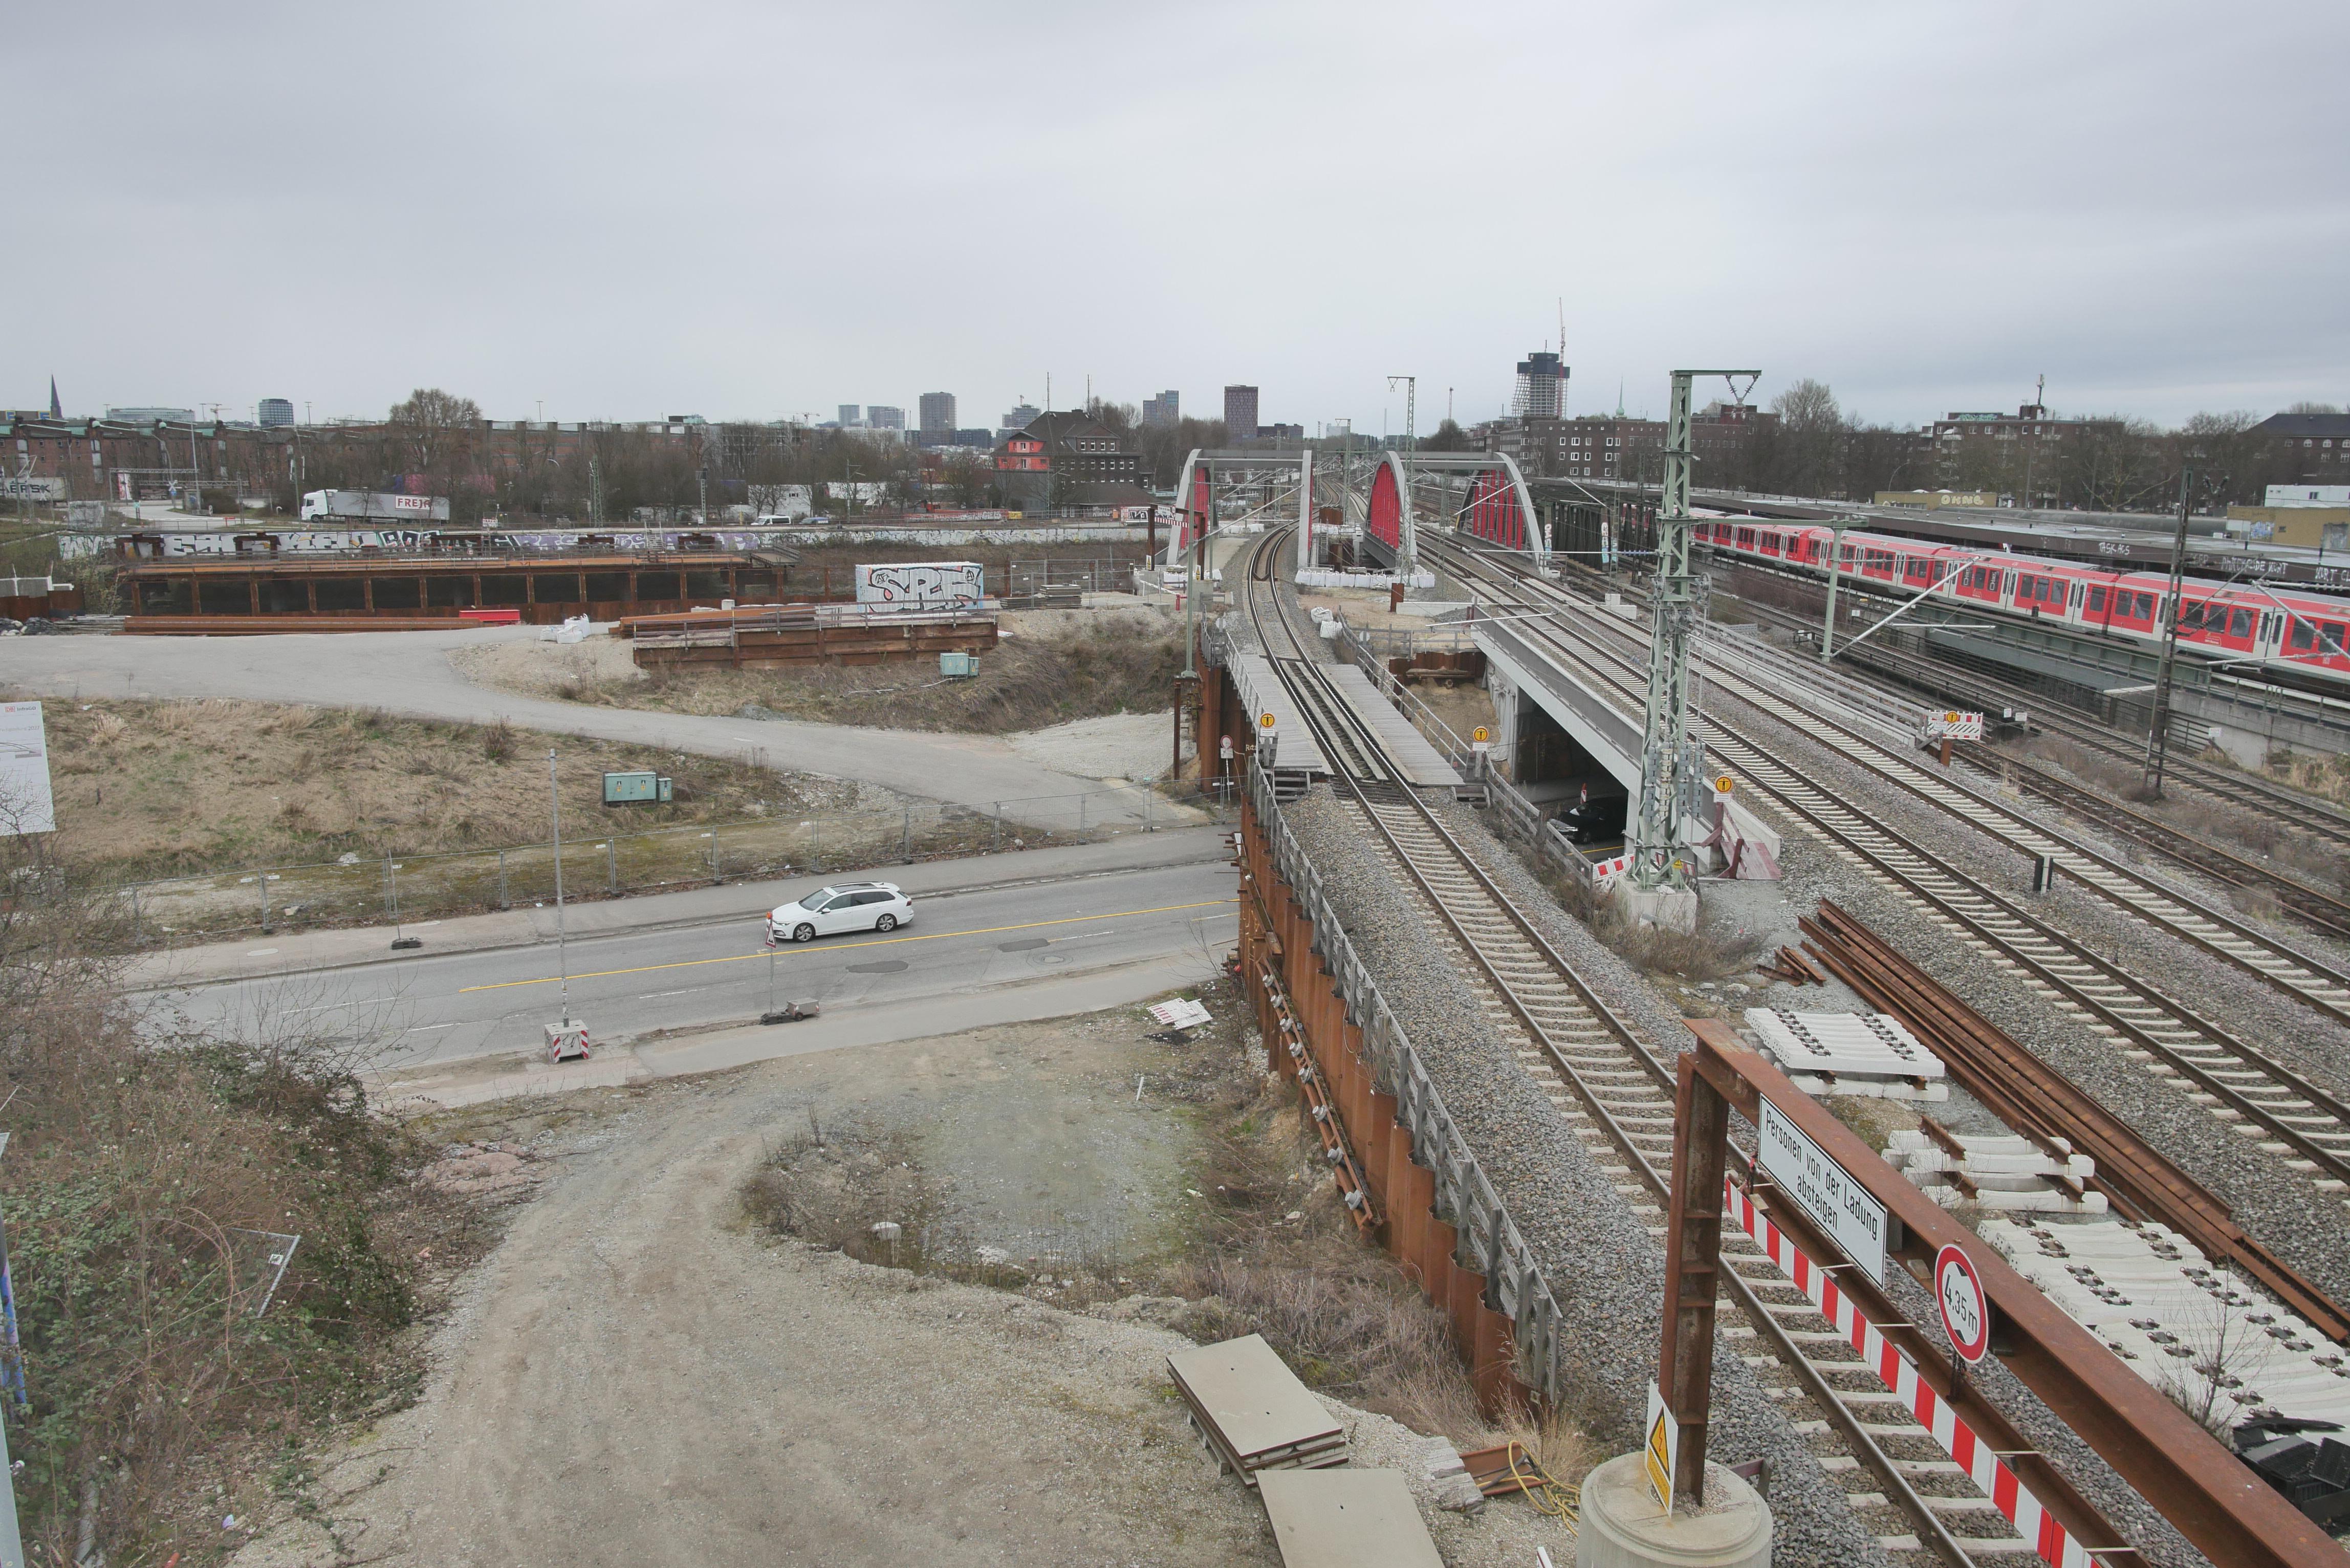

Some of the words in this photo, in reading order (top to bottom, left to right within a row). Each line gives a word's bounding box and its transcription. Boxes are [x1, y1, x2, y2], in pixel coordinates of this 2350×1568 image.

[398, 498, 431, 508] FREJA
[1766, 1109, 1802, 1163] Personen
[1806, 1151, 1821, 1182] von
[1825, 1168, 1840, 1200] der
[1844, 1186, 1878, 1241] Ladung
[1797, 1173, 1838, 1230] absteigen
